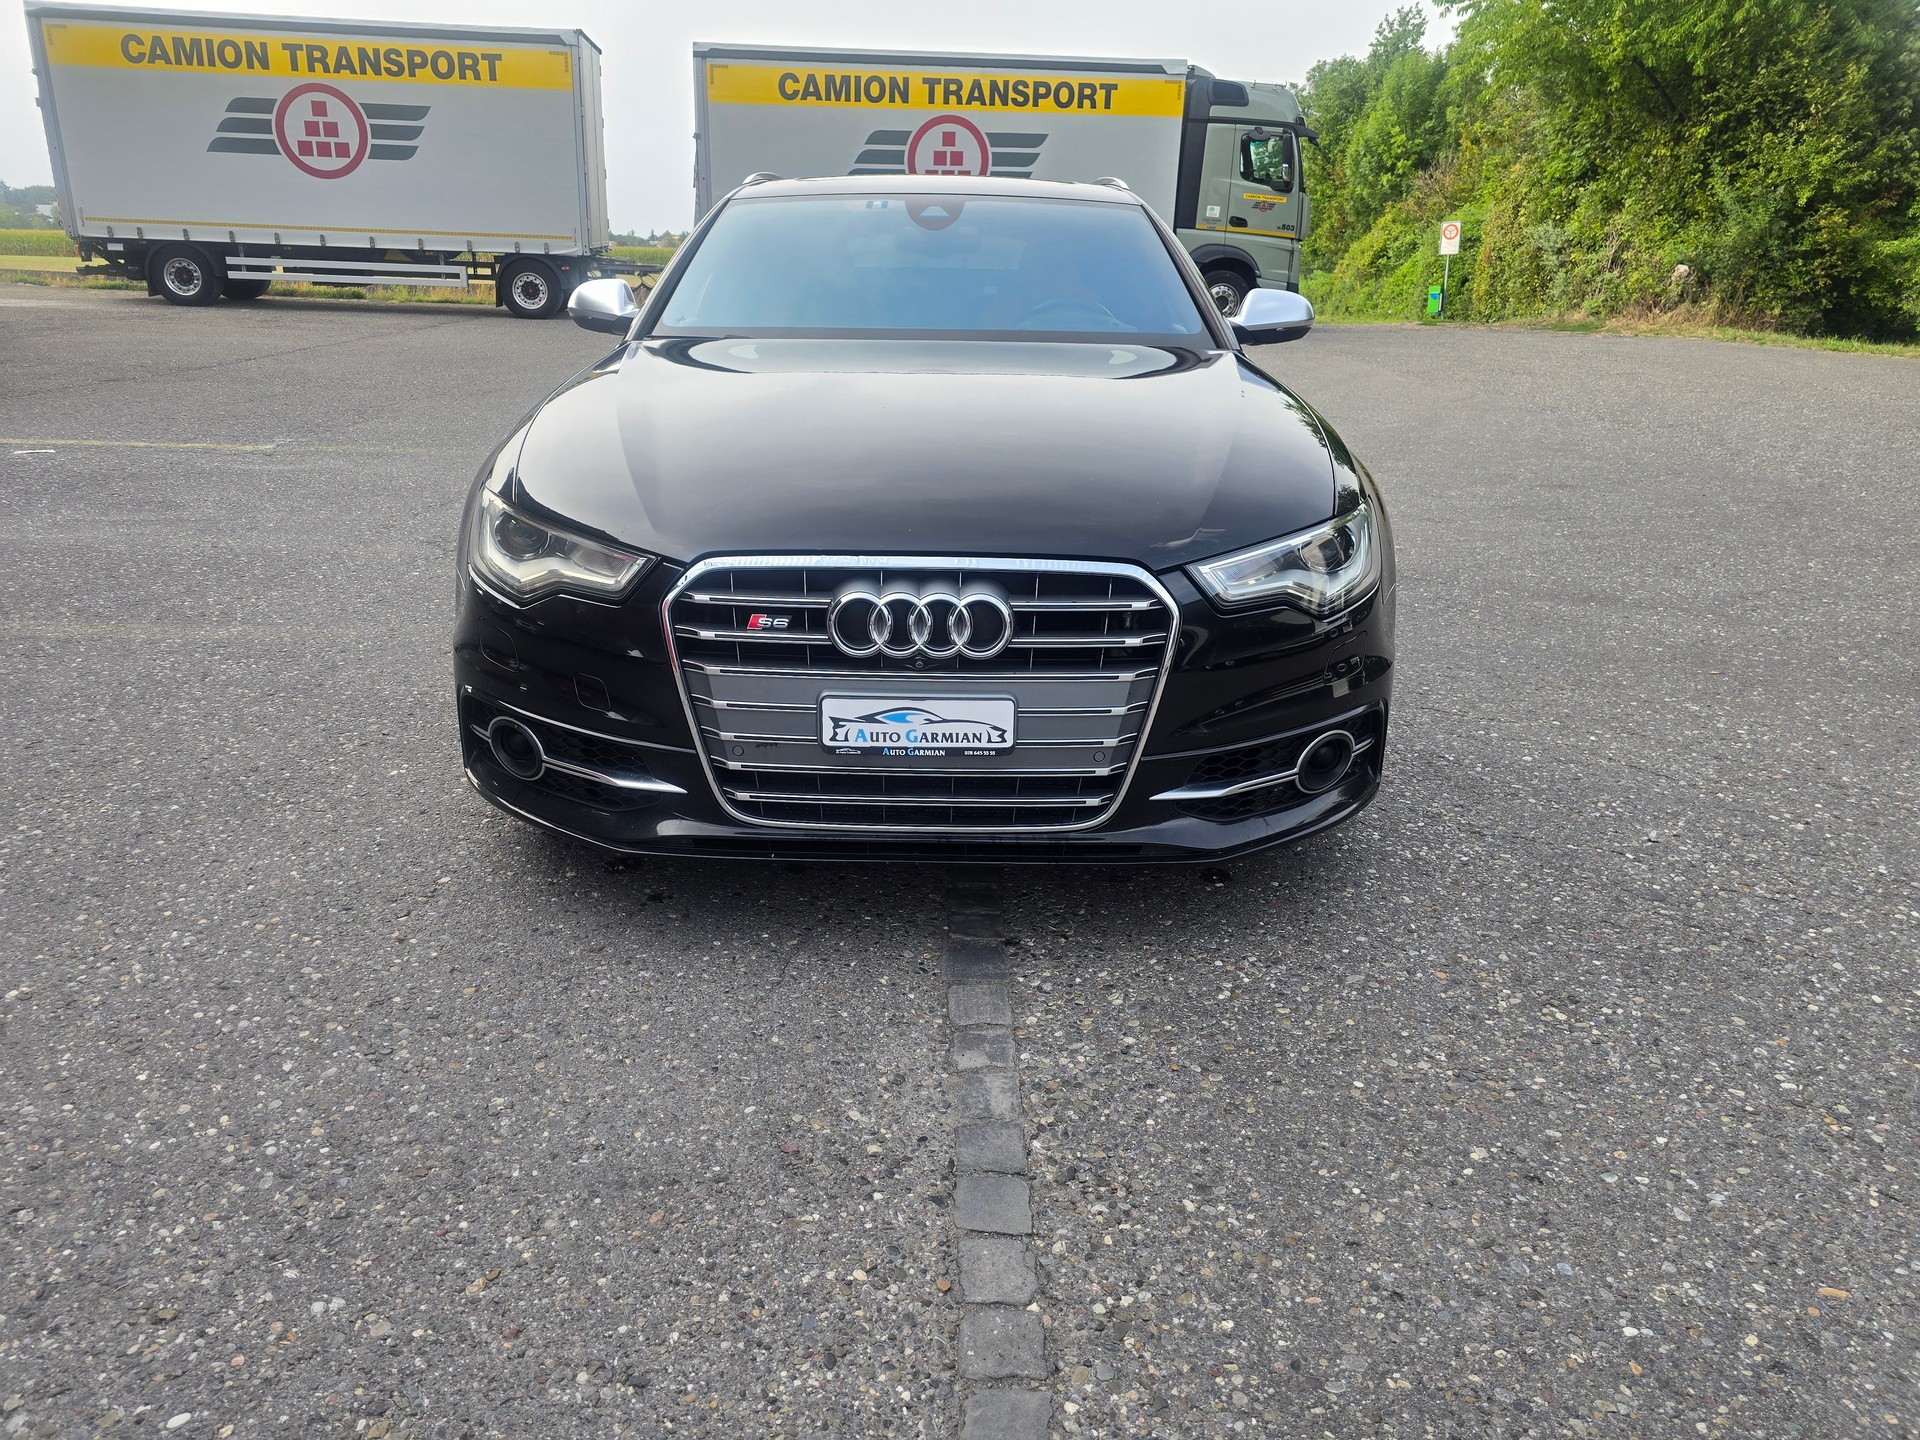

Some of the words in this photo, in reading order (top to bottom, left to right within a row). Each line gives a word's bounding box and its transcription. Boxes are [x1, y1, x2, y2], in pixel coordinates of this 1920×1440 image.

[120, 33, 270, 71] CAMION
[281, 42, 502, 82] TRANSPORT
[778, 72, 909, 104] CAMION
[922, 77, 1118, 110] TRANSPORT
[757, 617, 789, 628] S6
